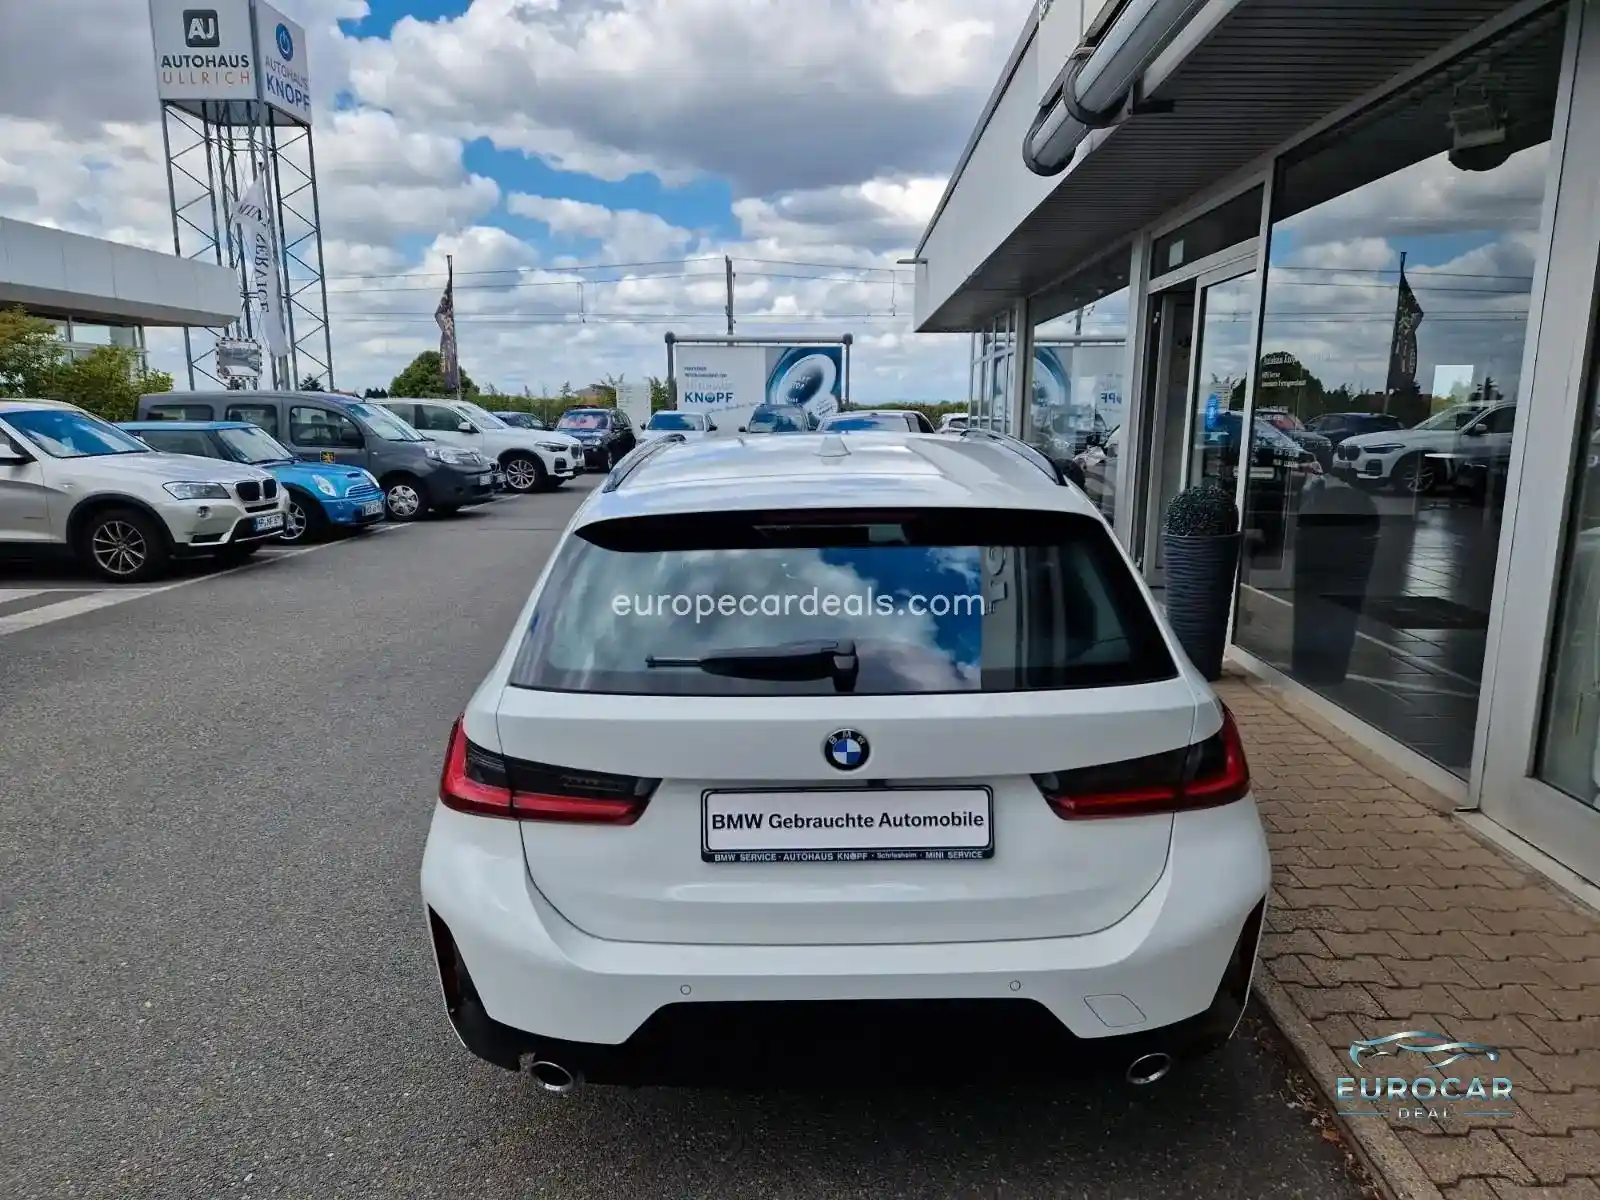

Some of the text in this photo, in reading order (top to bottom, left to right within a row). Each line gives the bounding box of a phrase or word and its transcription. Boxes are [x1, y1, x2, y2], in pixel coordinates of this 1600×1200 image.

[161, 54, 250, 69] AUTOHAUS
[163, 71, 250, 85] ULLRICH
[265, 55, 309, 90] AUTOHAUS
[266, 72, 310, 112] KNOPF
[684, 392, 734, 403] KNOPF
[712, 811, 984, 829] BMW Gebrauchte Automobile
[714, 853, 736, 861] BMW
[740, 853, 777, 861] SERVICE
[783, 853, 834, 861] AUTOHAUS
[837, 852, 868, 860] KNOPF
[925, 851, 944, 859] MINI
[947, 851, 983, 859] SERVICE
